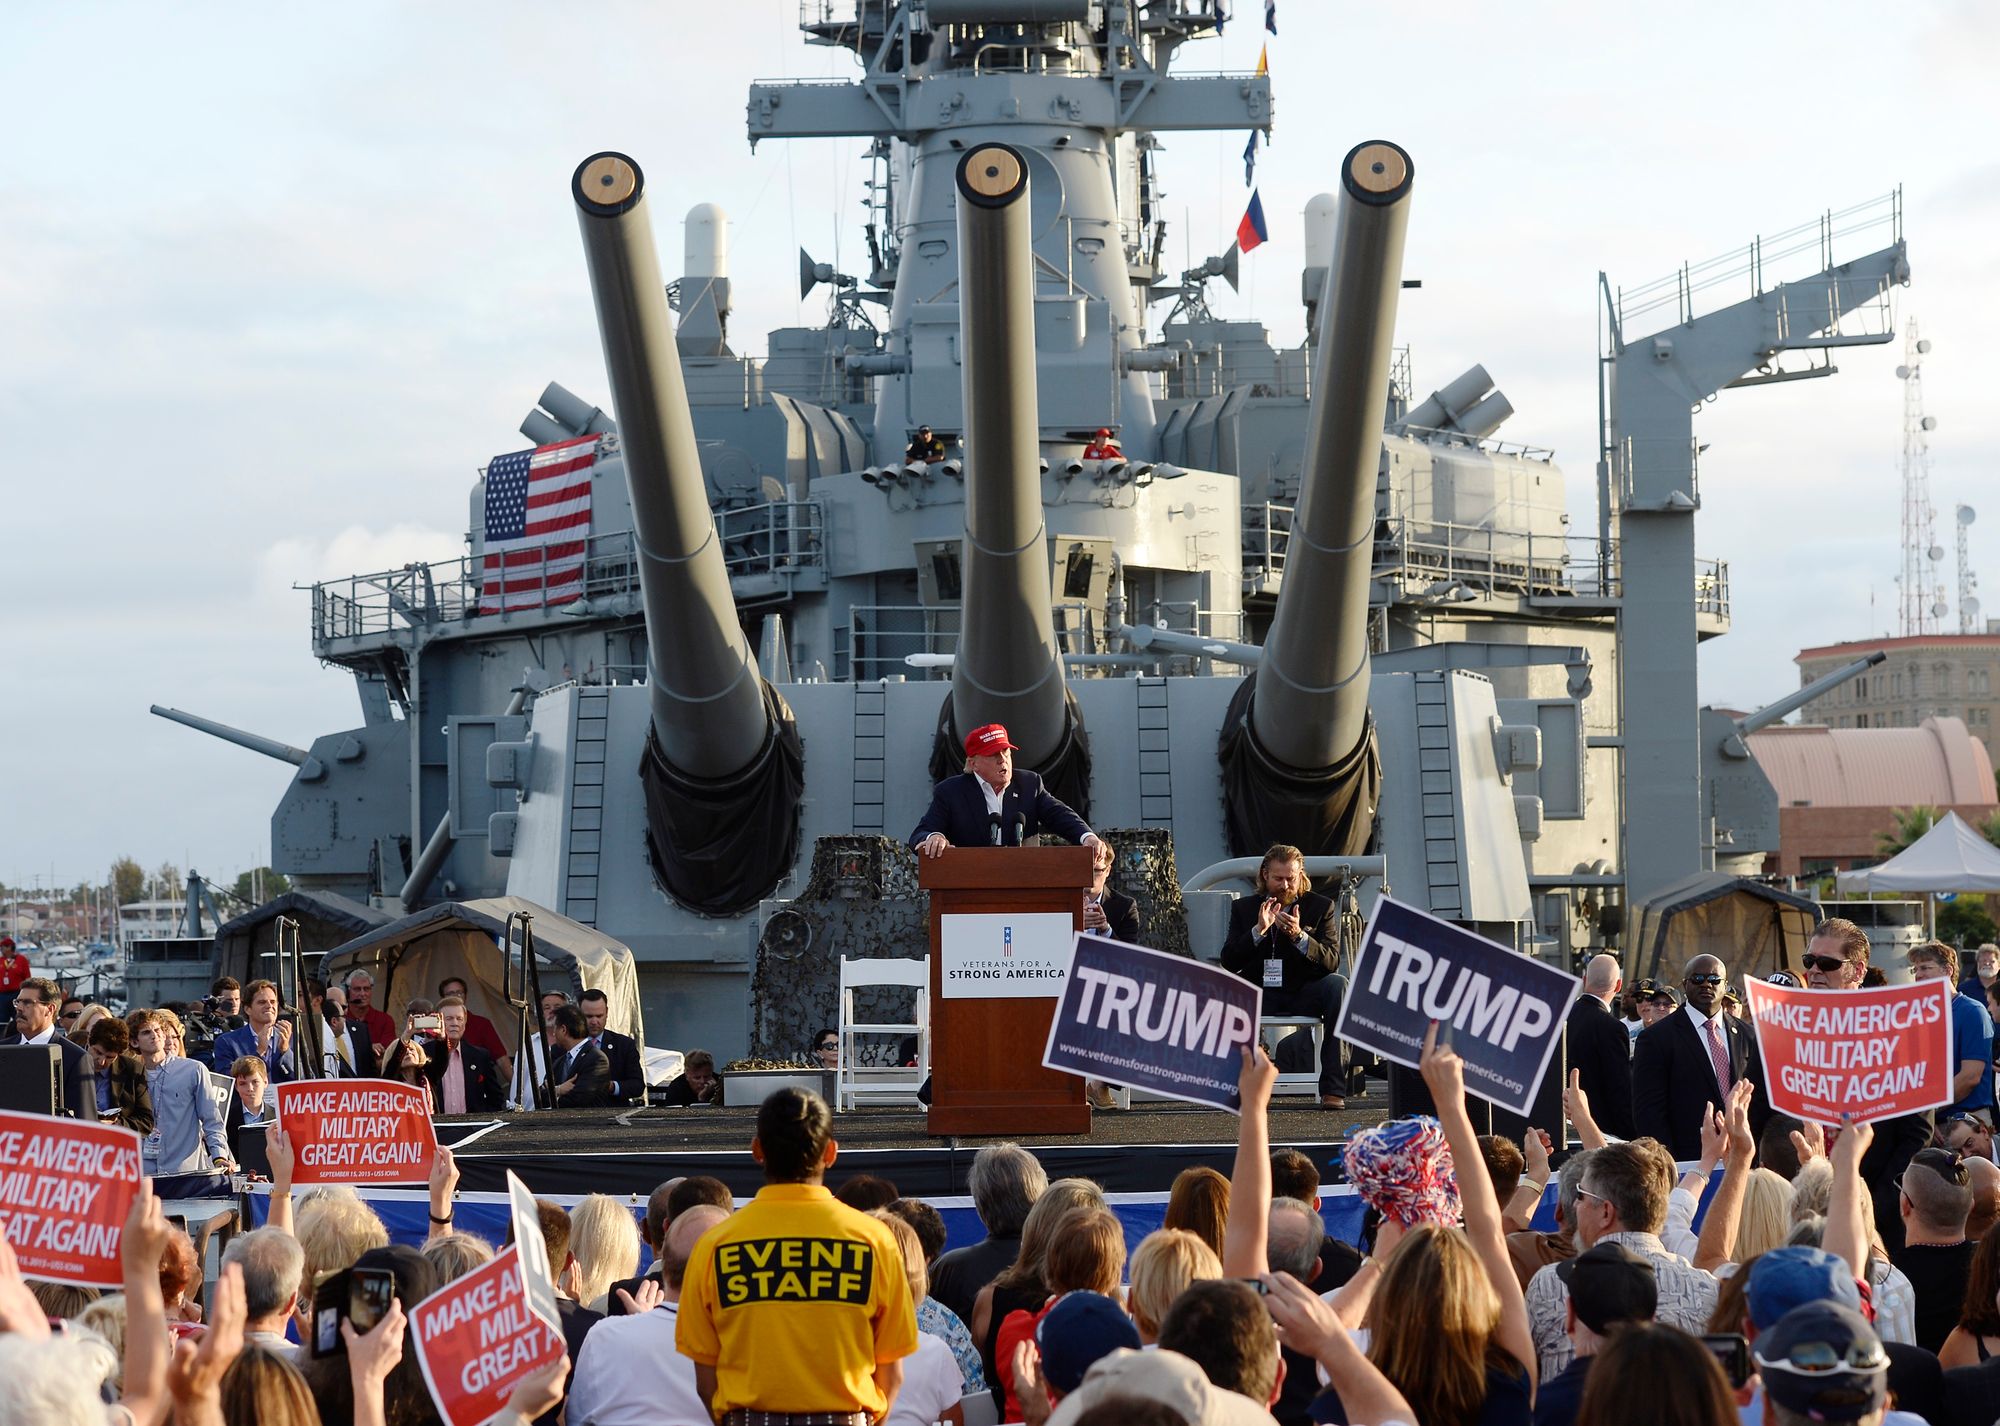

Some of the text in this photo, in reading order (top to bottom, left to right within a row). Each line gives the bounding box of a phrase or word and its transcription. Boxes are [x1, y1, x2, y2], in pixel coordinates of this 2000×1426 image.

[949, 969, 1065, 979] STRONG AMERICA
[1020, 960, 1040, 968] FOR
[1076, 965, 1252, 1059] TRUMP
[1368, 931, 1552, 1053] TRUMP
[1757, 994, 1940, 1035] MAKE AMERICA'S
[1059, 1042, 1239, 1095] www.veteransforastrongamerica.org
[1795, 1035, 1900, 1069] MILITARY
[1781, 1061, 1927, 1103] GREAT AGAIN!
[284, 1091, 336, 1115] MAKE
[338, 1091, 424, 1116] AMERICA'S
[320, 1117, 400, 1139] MILITARY
[20, 1135, 138, 1183] AMERICA'S
[301, 1142, 423, 1165] GREAT AGAIN!
[34, 1216, 121, 1260] AGAIN!
[720, 1241, 870, 1274] EVENT
[727, 1271, 861, 1302] STAFF
[424, 1279, 497, 1343] MAKE
[461, 1326, 541, 1395] GREAT
